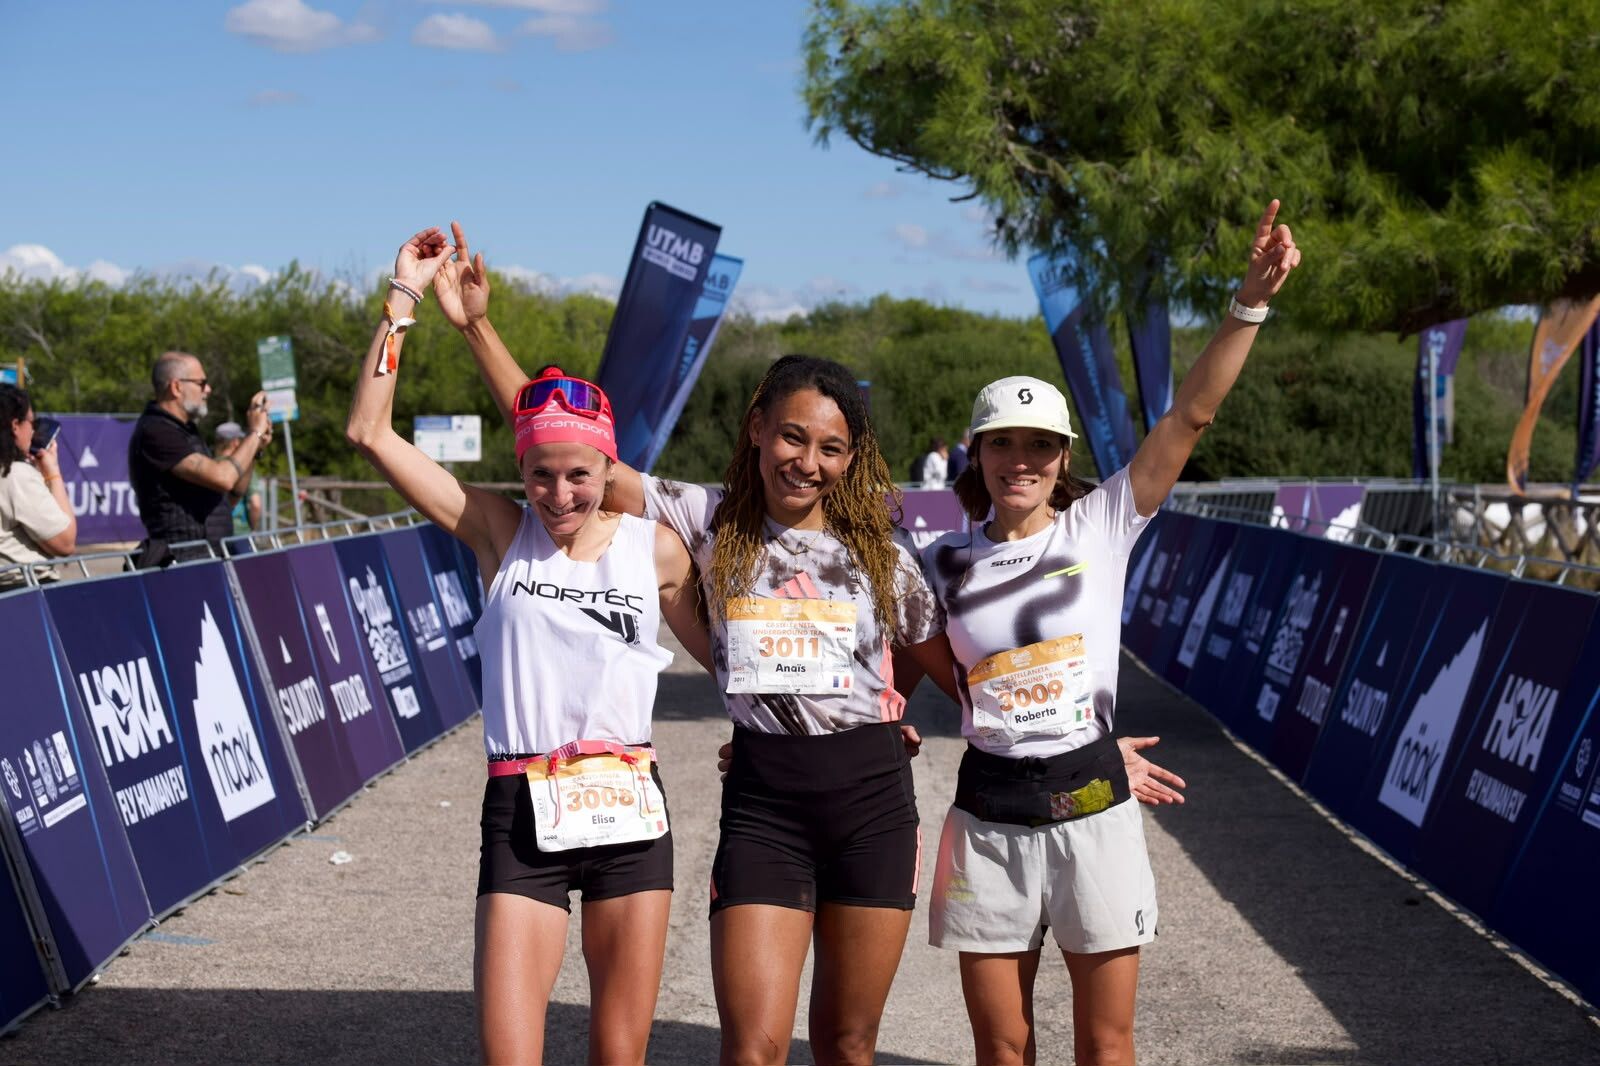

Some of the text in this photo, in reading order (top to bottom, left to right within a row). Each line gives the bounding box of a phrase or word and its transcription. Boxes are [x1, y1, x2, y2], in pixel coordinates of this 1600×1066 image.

[647, 224, 704, 265] UTMB
[65, 481, 140, 516] UNT
[990, 555, 1034, 568] SCOTT
[512, 581, 643, 614] NORTEC
[759, 636, 819, 657] 3011
[775, 663, 806, 673] Anaïs
[80, 657, 174, 767] HOKA
[278, 675, 326, 736] SUUNTO
[998, 680, 1063, 712] 3009
[1014, 708, 1057, 723] Roberta
[115, 765, 189, 827] FLY HUMAN FLY
[591, 814, 616, 825] Elisa
